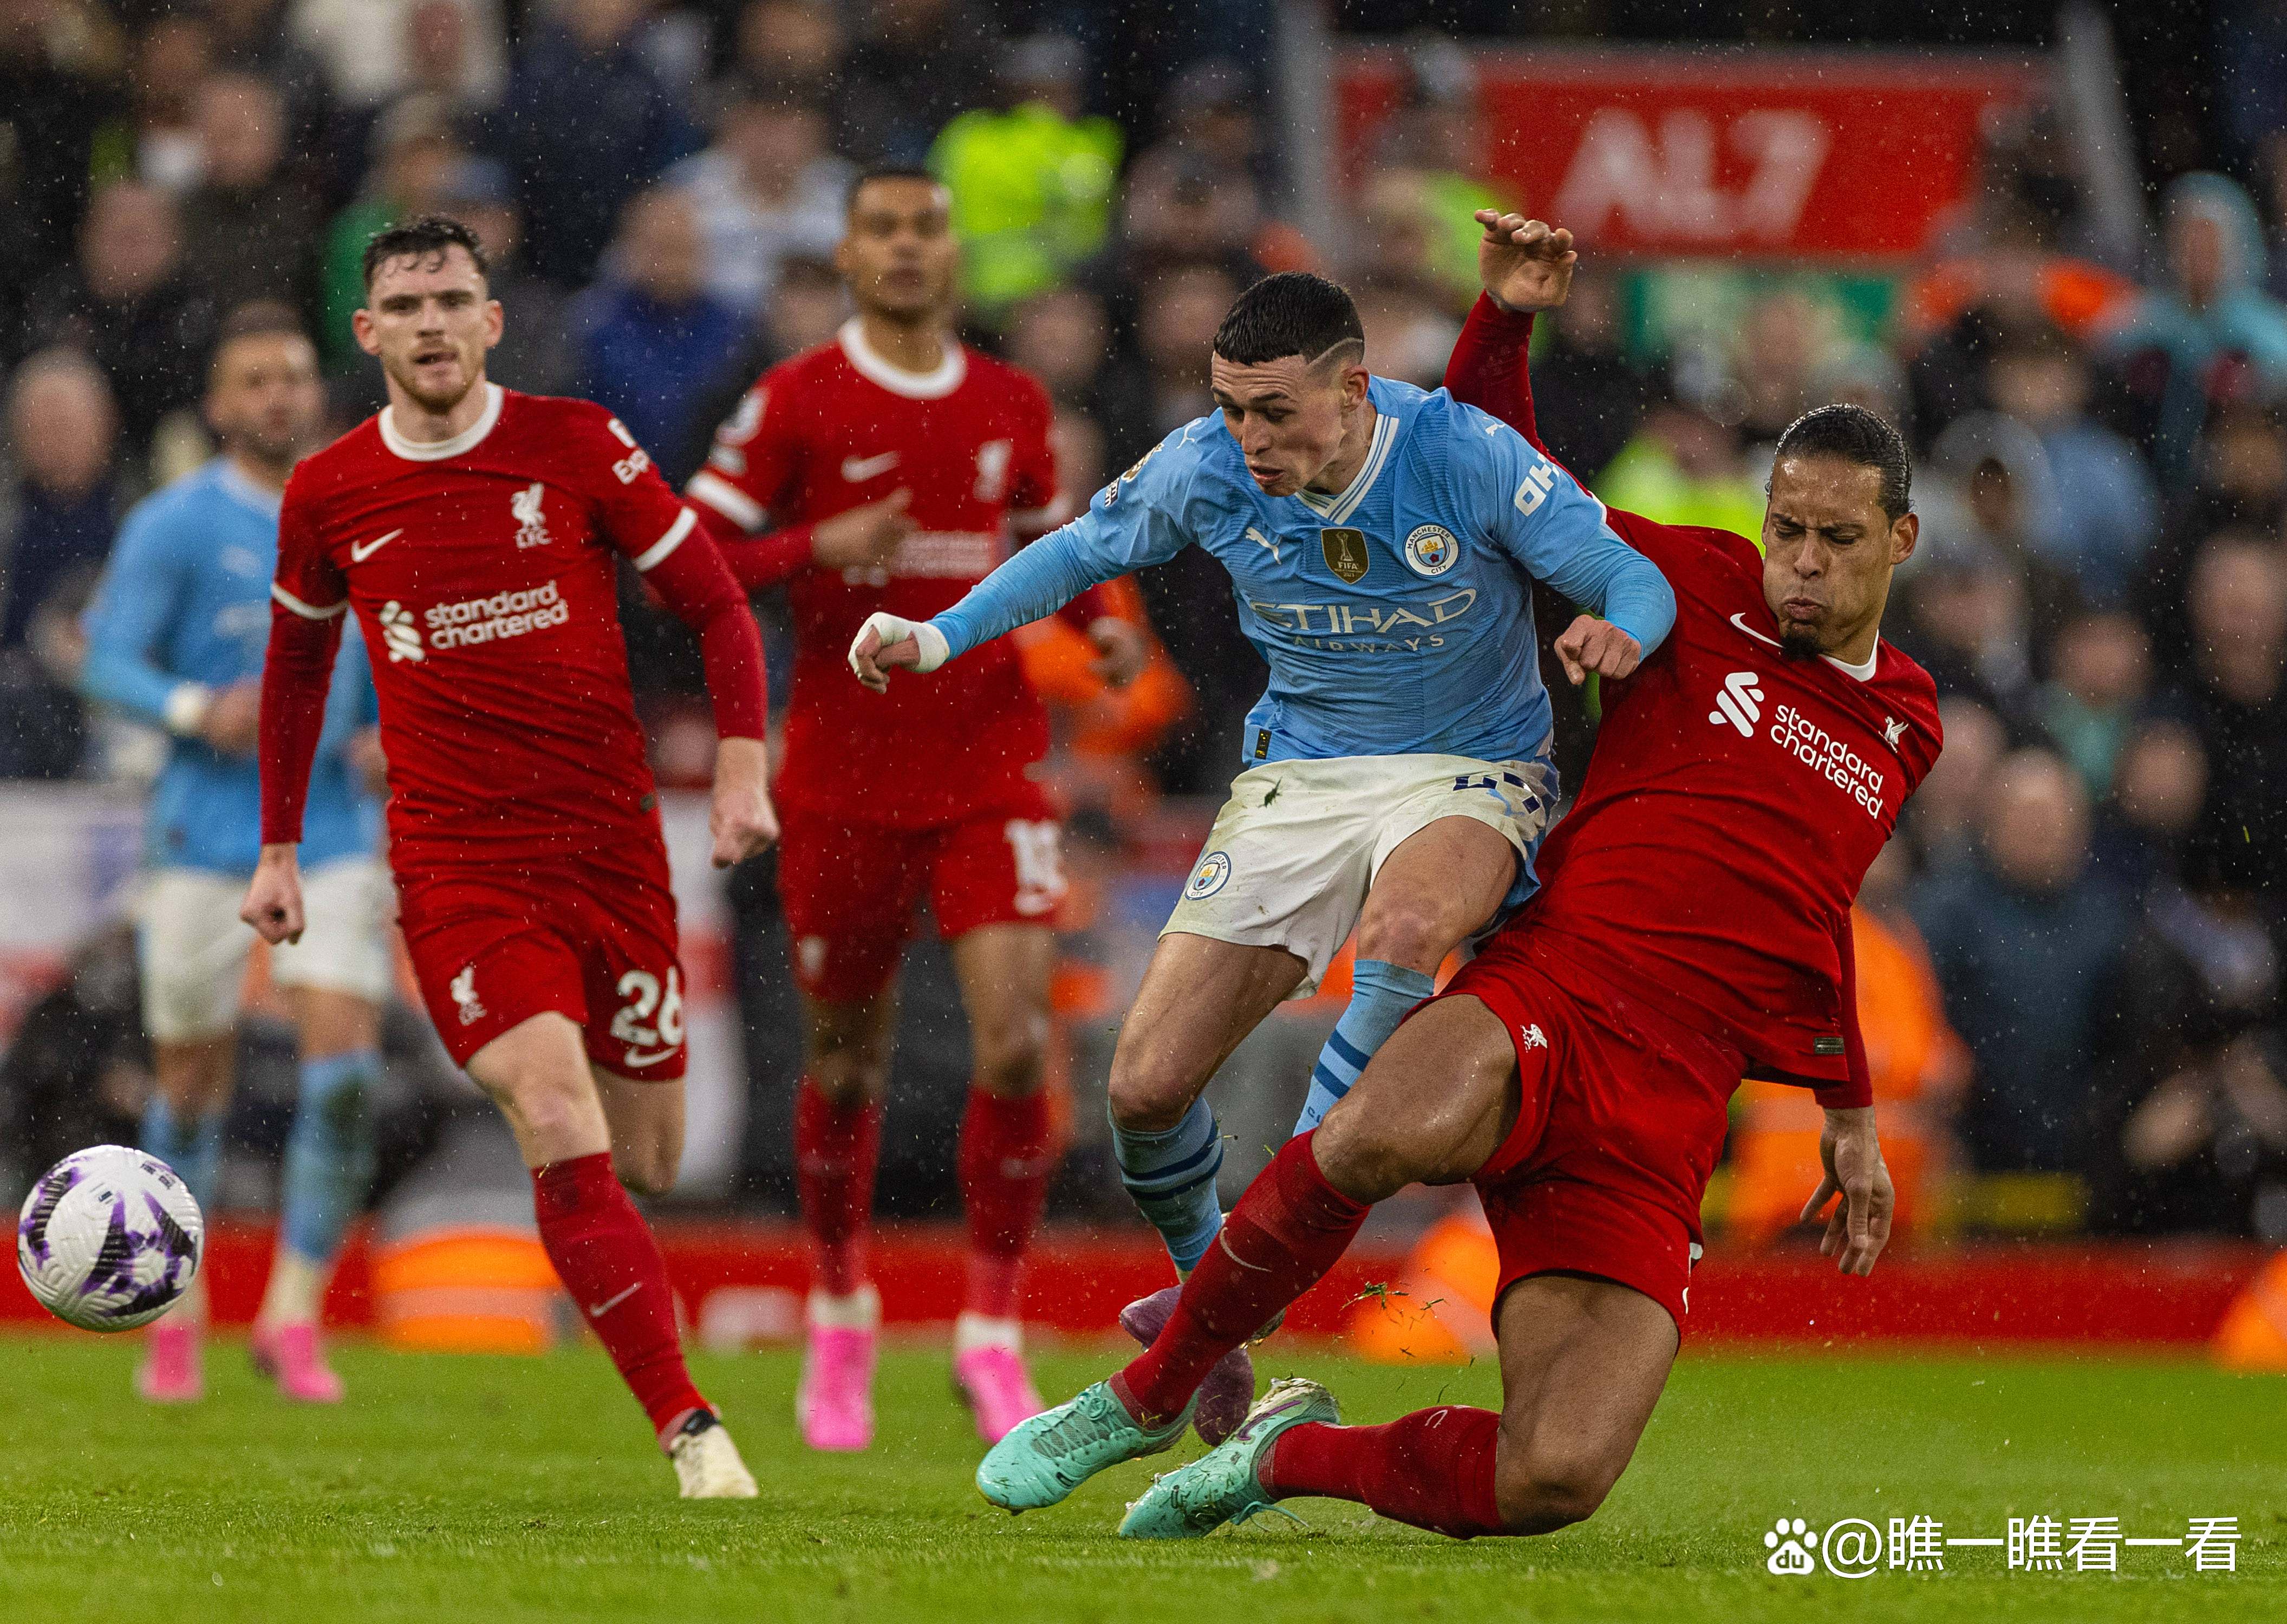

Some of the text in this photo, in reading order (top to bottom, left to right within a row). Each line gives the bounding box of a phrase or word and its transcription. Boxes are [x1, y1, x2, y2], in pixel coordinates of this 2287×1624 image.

[1408, 526, 1450, 549] MANCHESTER
[1338, 562, 1358, 570] FIFA
[1431, 565, 1447, 574] CITY
[425, 580, 559, 629] standard
[430, 598, 570, 649] chartered
[1250, 588, 1477, 633] ETIHAD
[1770, 725, 1883, 819] chartered
[1775, 705, 1884, 794] standard
[610, 966, 684, 1046] 26
